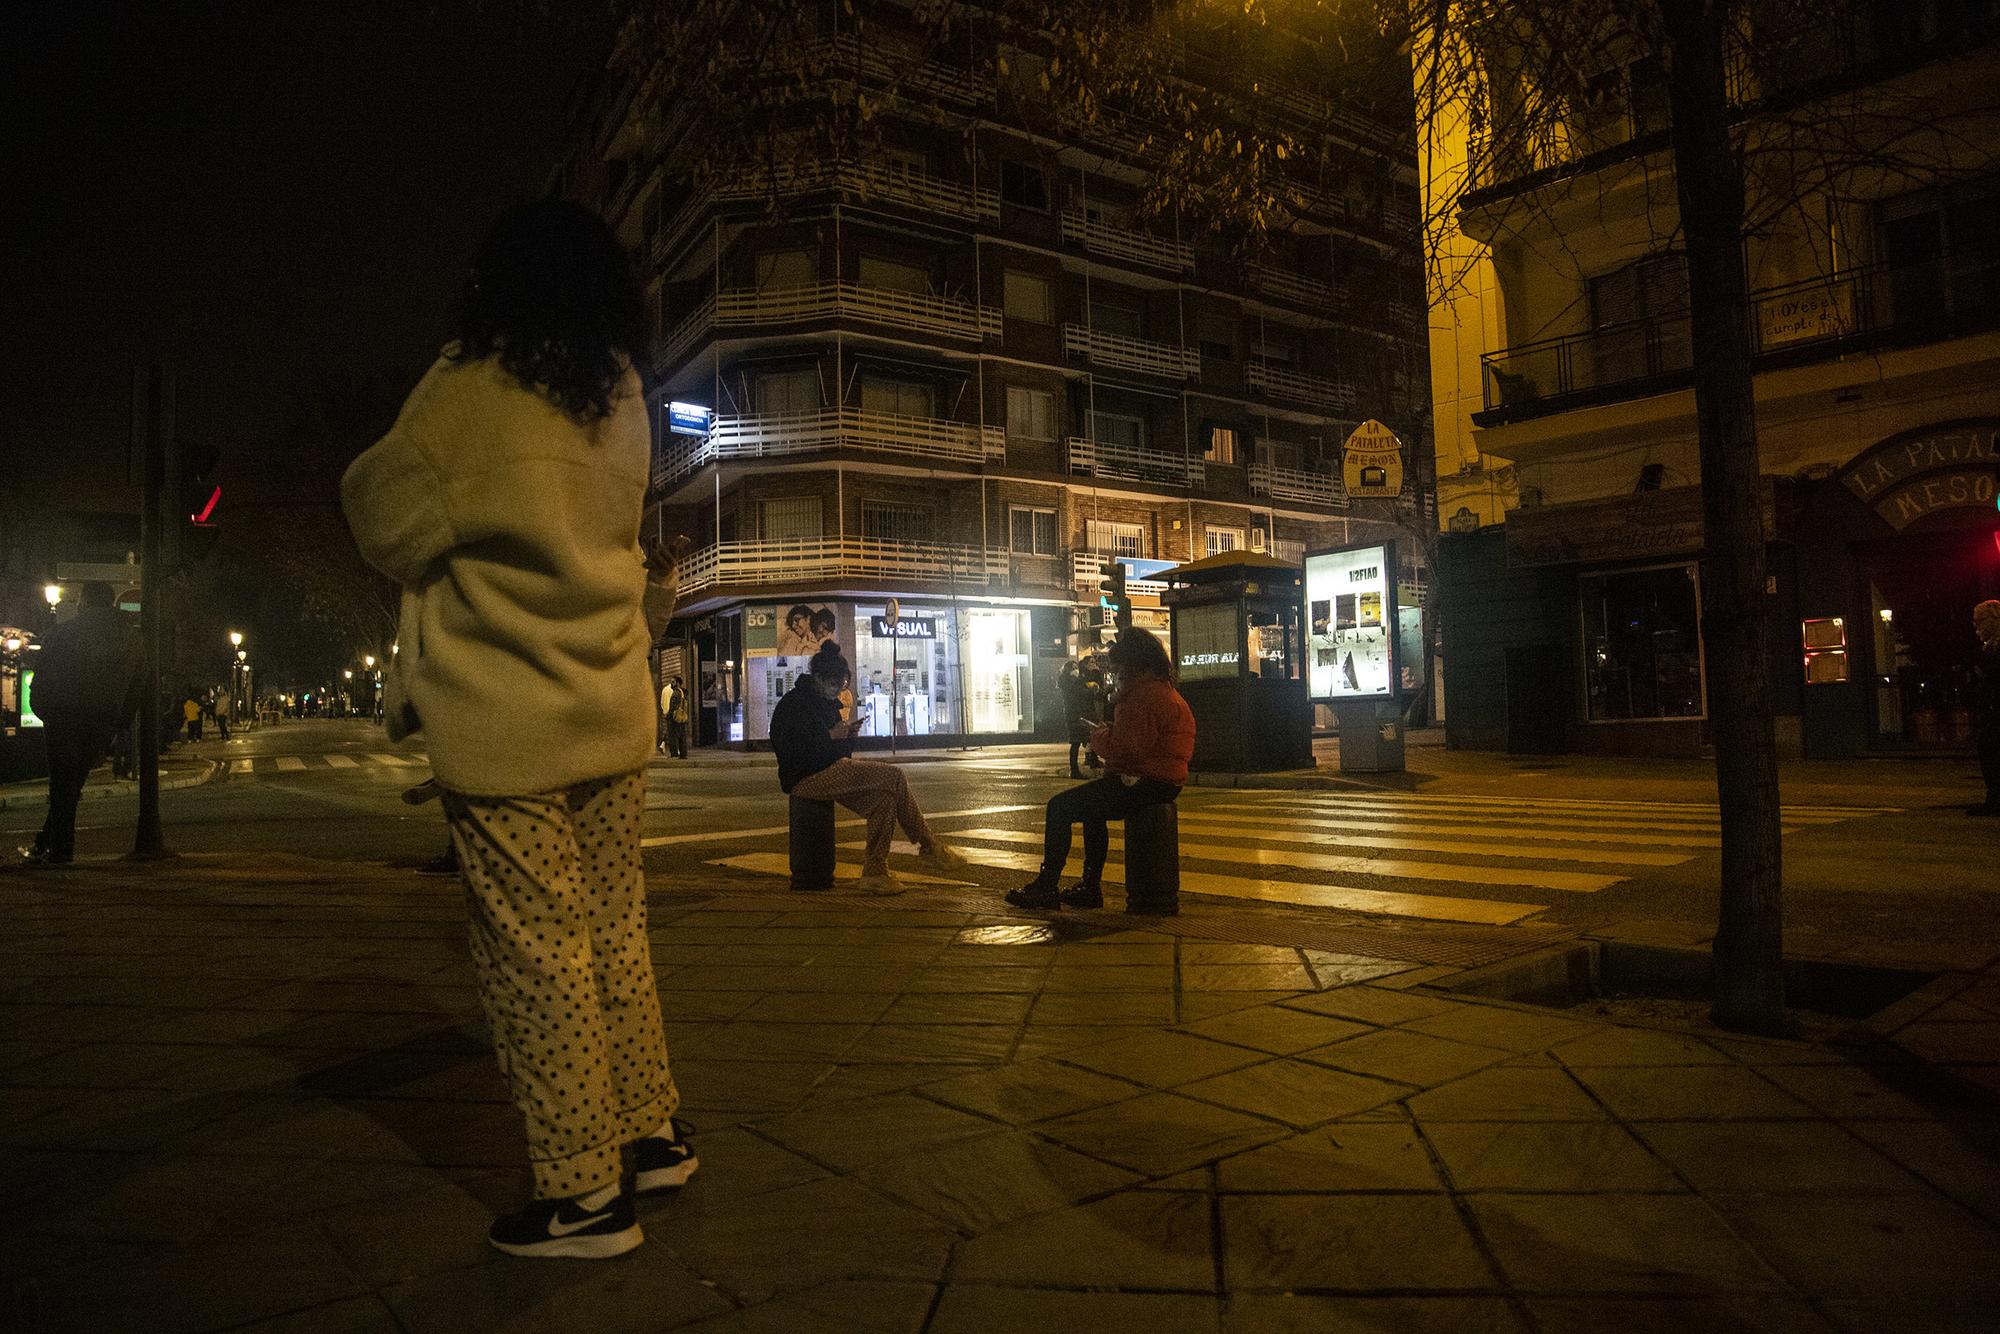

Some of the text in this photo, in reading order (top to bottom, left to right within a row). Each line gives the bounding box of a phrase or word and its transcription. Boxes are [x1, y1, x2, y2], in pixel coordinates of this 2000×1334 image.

[1367, 422, 1380, 434] LA
[1350, 435, 1398, 449] PATALETA
[1854, 460, 1895, 494] LA
